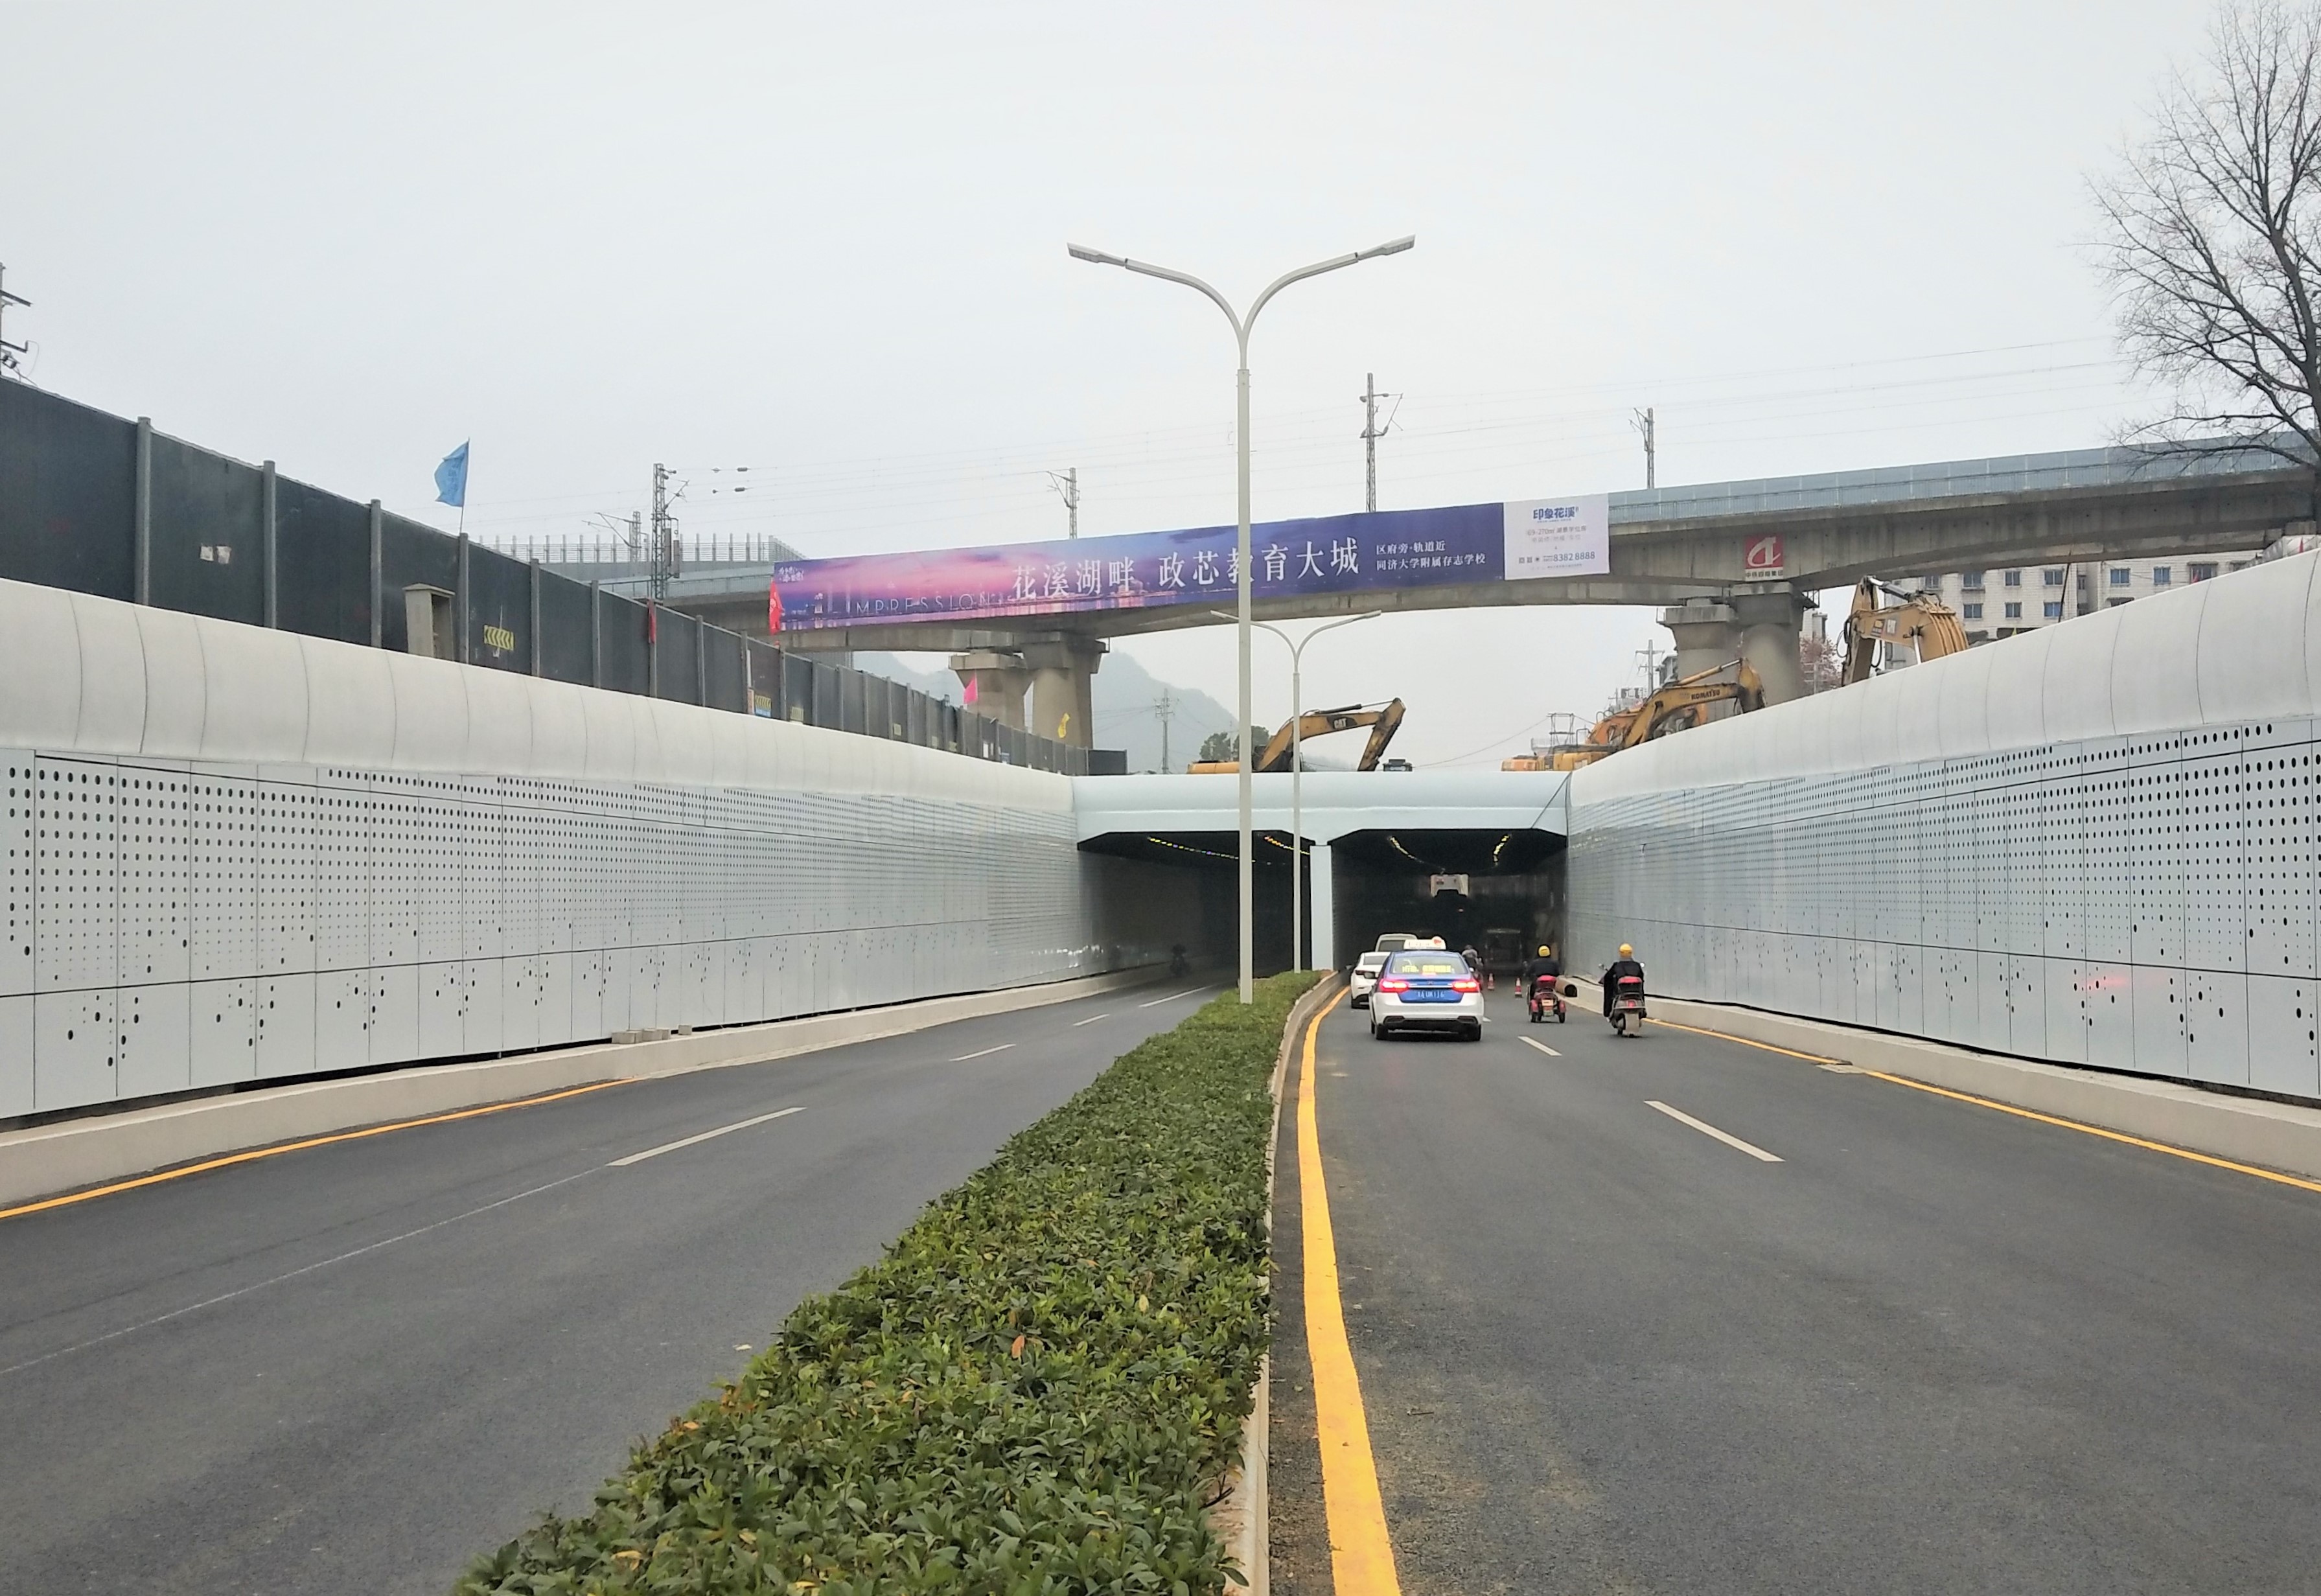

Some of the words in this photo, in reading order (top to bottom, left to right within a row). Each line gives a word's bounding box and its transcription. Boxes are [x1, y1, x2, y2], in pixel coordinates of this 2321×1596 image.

[1533, 506, 1575, 520] 印象花溪
[1376, 553, 1486, 571] 同济大学附属存志学校
[1011, 556, 1135, 599] 花溪湖畔
[1691, 689, 1720, 700] KOMATSU
[1334, 717, 1347, 729] CAT
